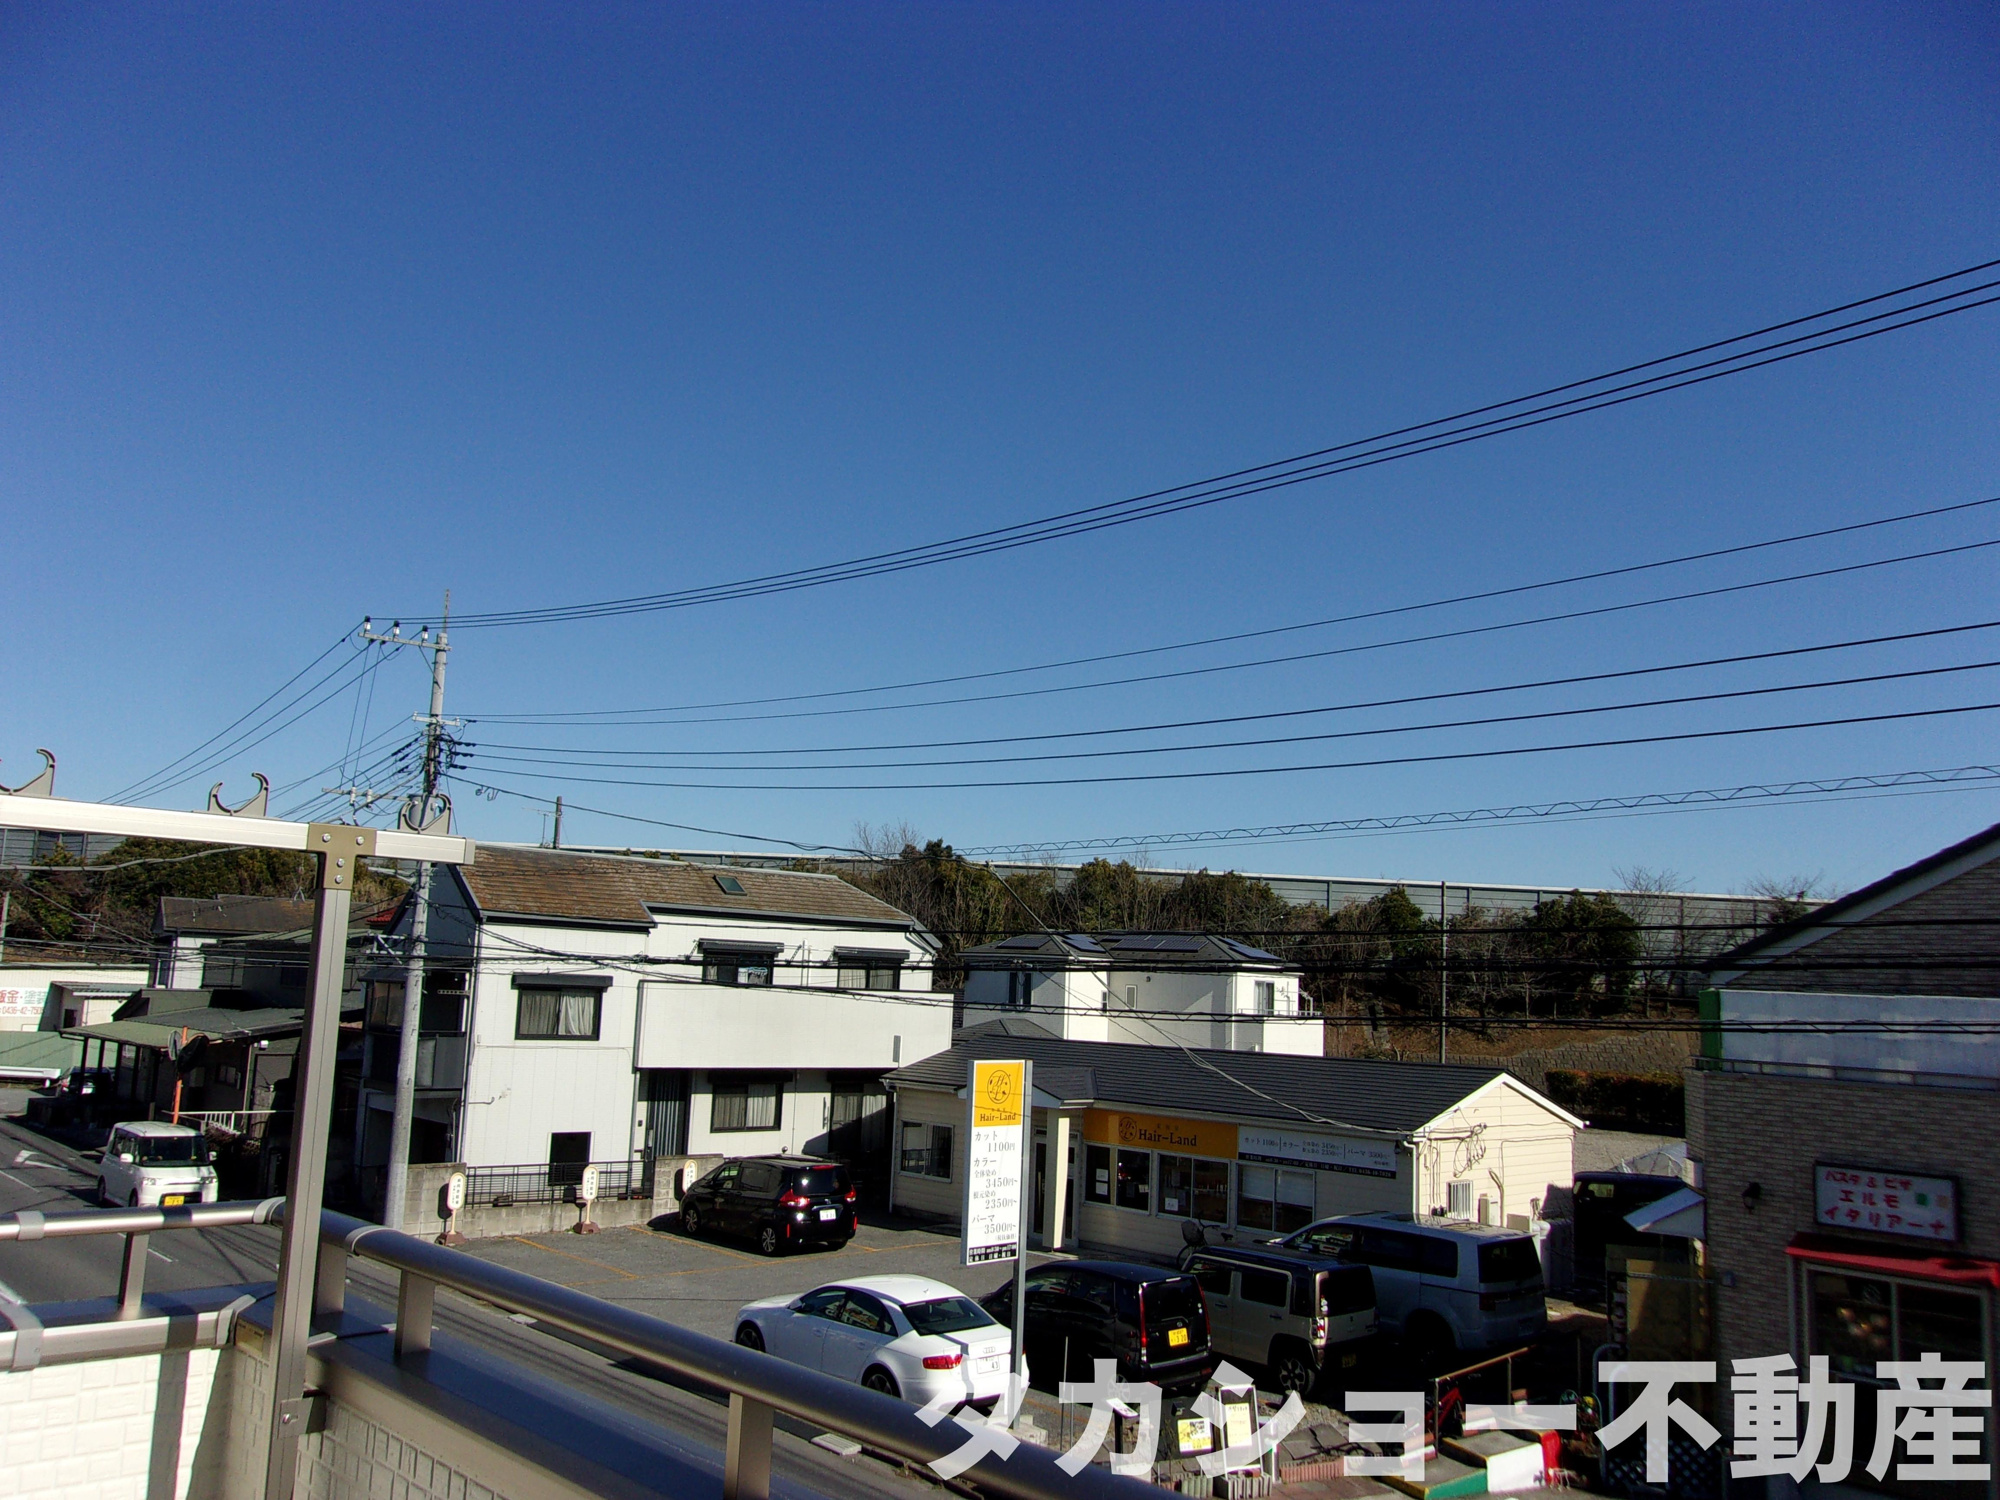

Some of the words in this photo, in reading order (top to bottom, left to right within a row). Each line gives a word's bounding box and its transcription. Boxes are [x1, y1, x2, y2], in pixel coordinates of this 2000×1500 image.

[980, 1112, 1016, 1122] Hair-Land
[975, 1130, 998, 1142] カット
[1138, 1128, 1197, 1147] Hair-Land
[988, 1141, 1016, 1153] 1100円
[973, 1156, 997, 1168] カラー
[1824, 1170, 1862, 1185] パスタ
[1883, 1176, 1913, 1191] ピザ
[1838, 1189, 1900, 1209] エルモ
[971, 1213, 996, 1224] パーマ
[1822, 1205, 1946, 1236] イタリアーナ
